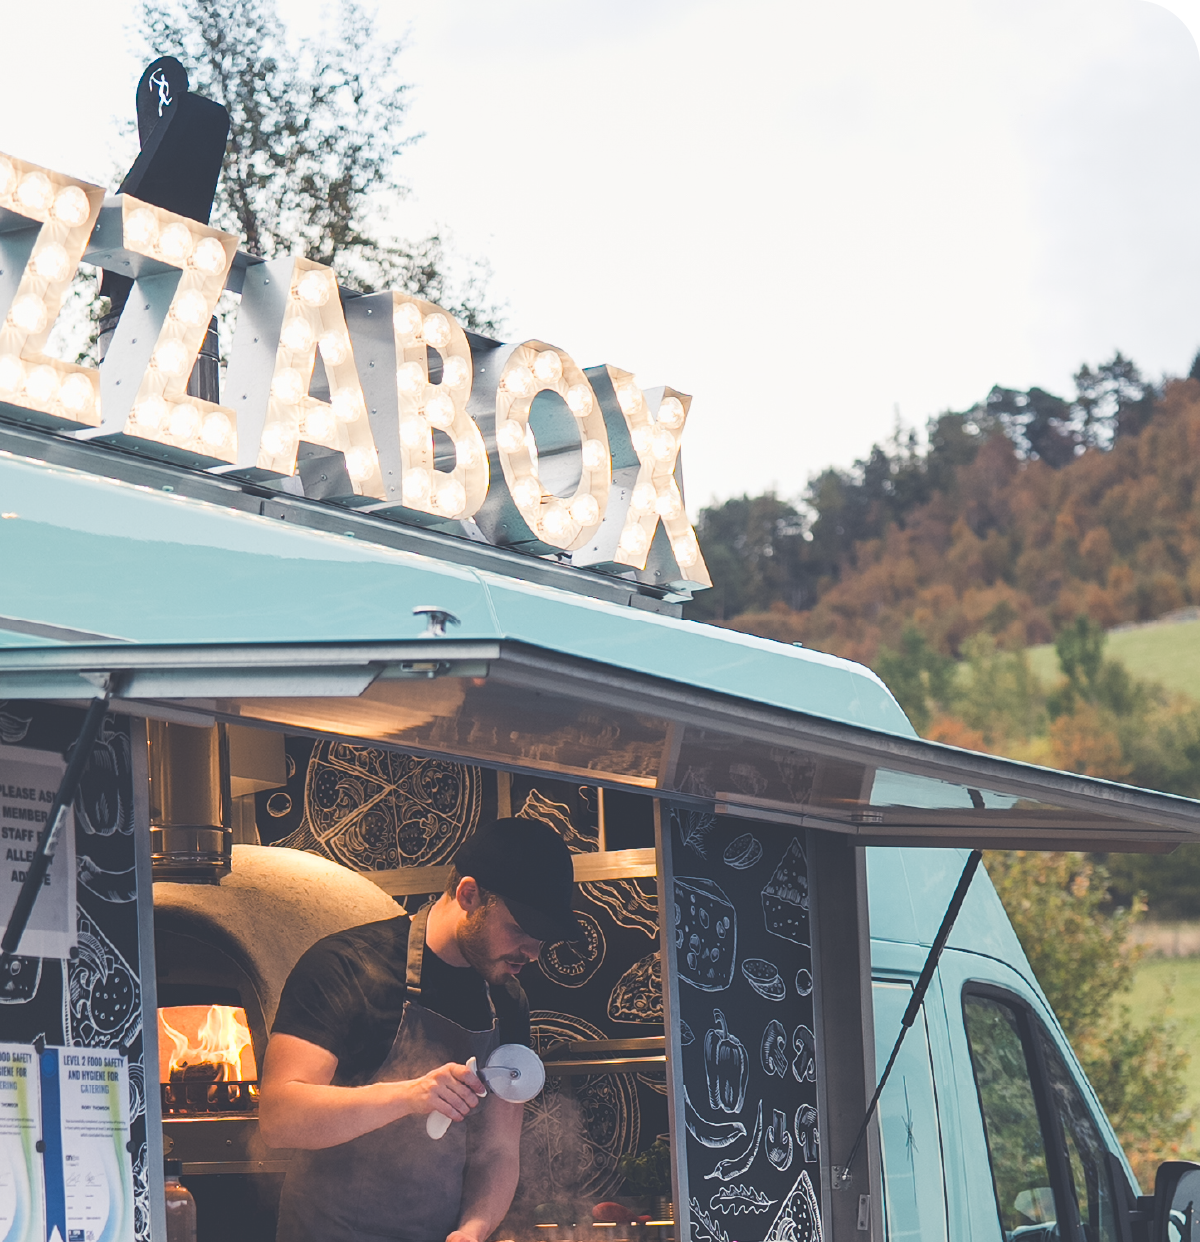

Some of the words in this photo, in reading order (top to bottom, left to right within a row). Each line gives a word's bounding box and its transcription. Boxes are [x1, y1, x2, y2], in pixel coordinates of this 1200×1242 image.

[2, 806, 48, 823] MEMBER
[1, 827, 34, 842] STAFF
[12, 1053, 32, 1064] SAFETY
[63, 1055, 80, 1066] LEVEL
[81, 1055, 86, 1067] 2
[87, 1056, 103, 1067] FOOD
[104, 1057, 125, 1068] SAFETY
[16, 1066, 27, 1077] FOR
[68, 1070, 80, 1080] AND
[81, 1070, 106, 1082] HYGIENE
[107, 1070, 119, 1082] FOR
[80, 1084, 110, 1095] CATERING
